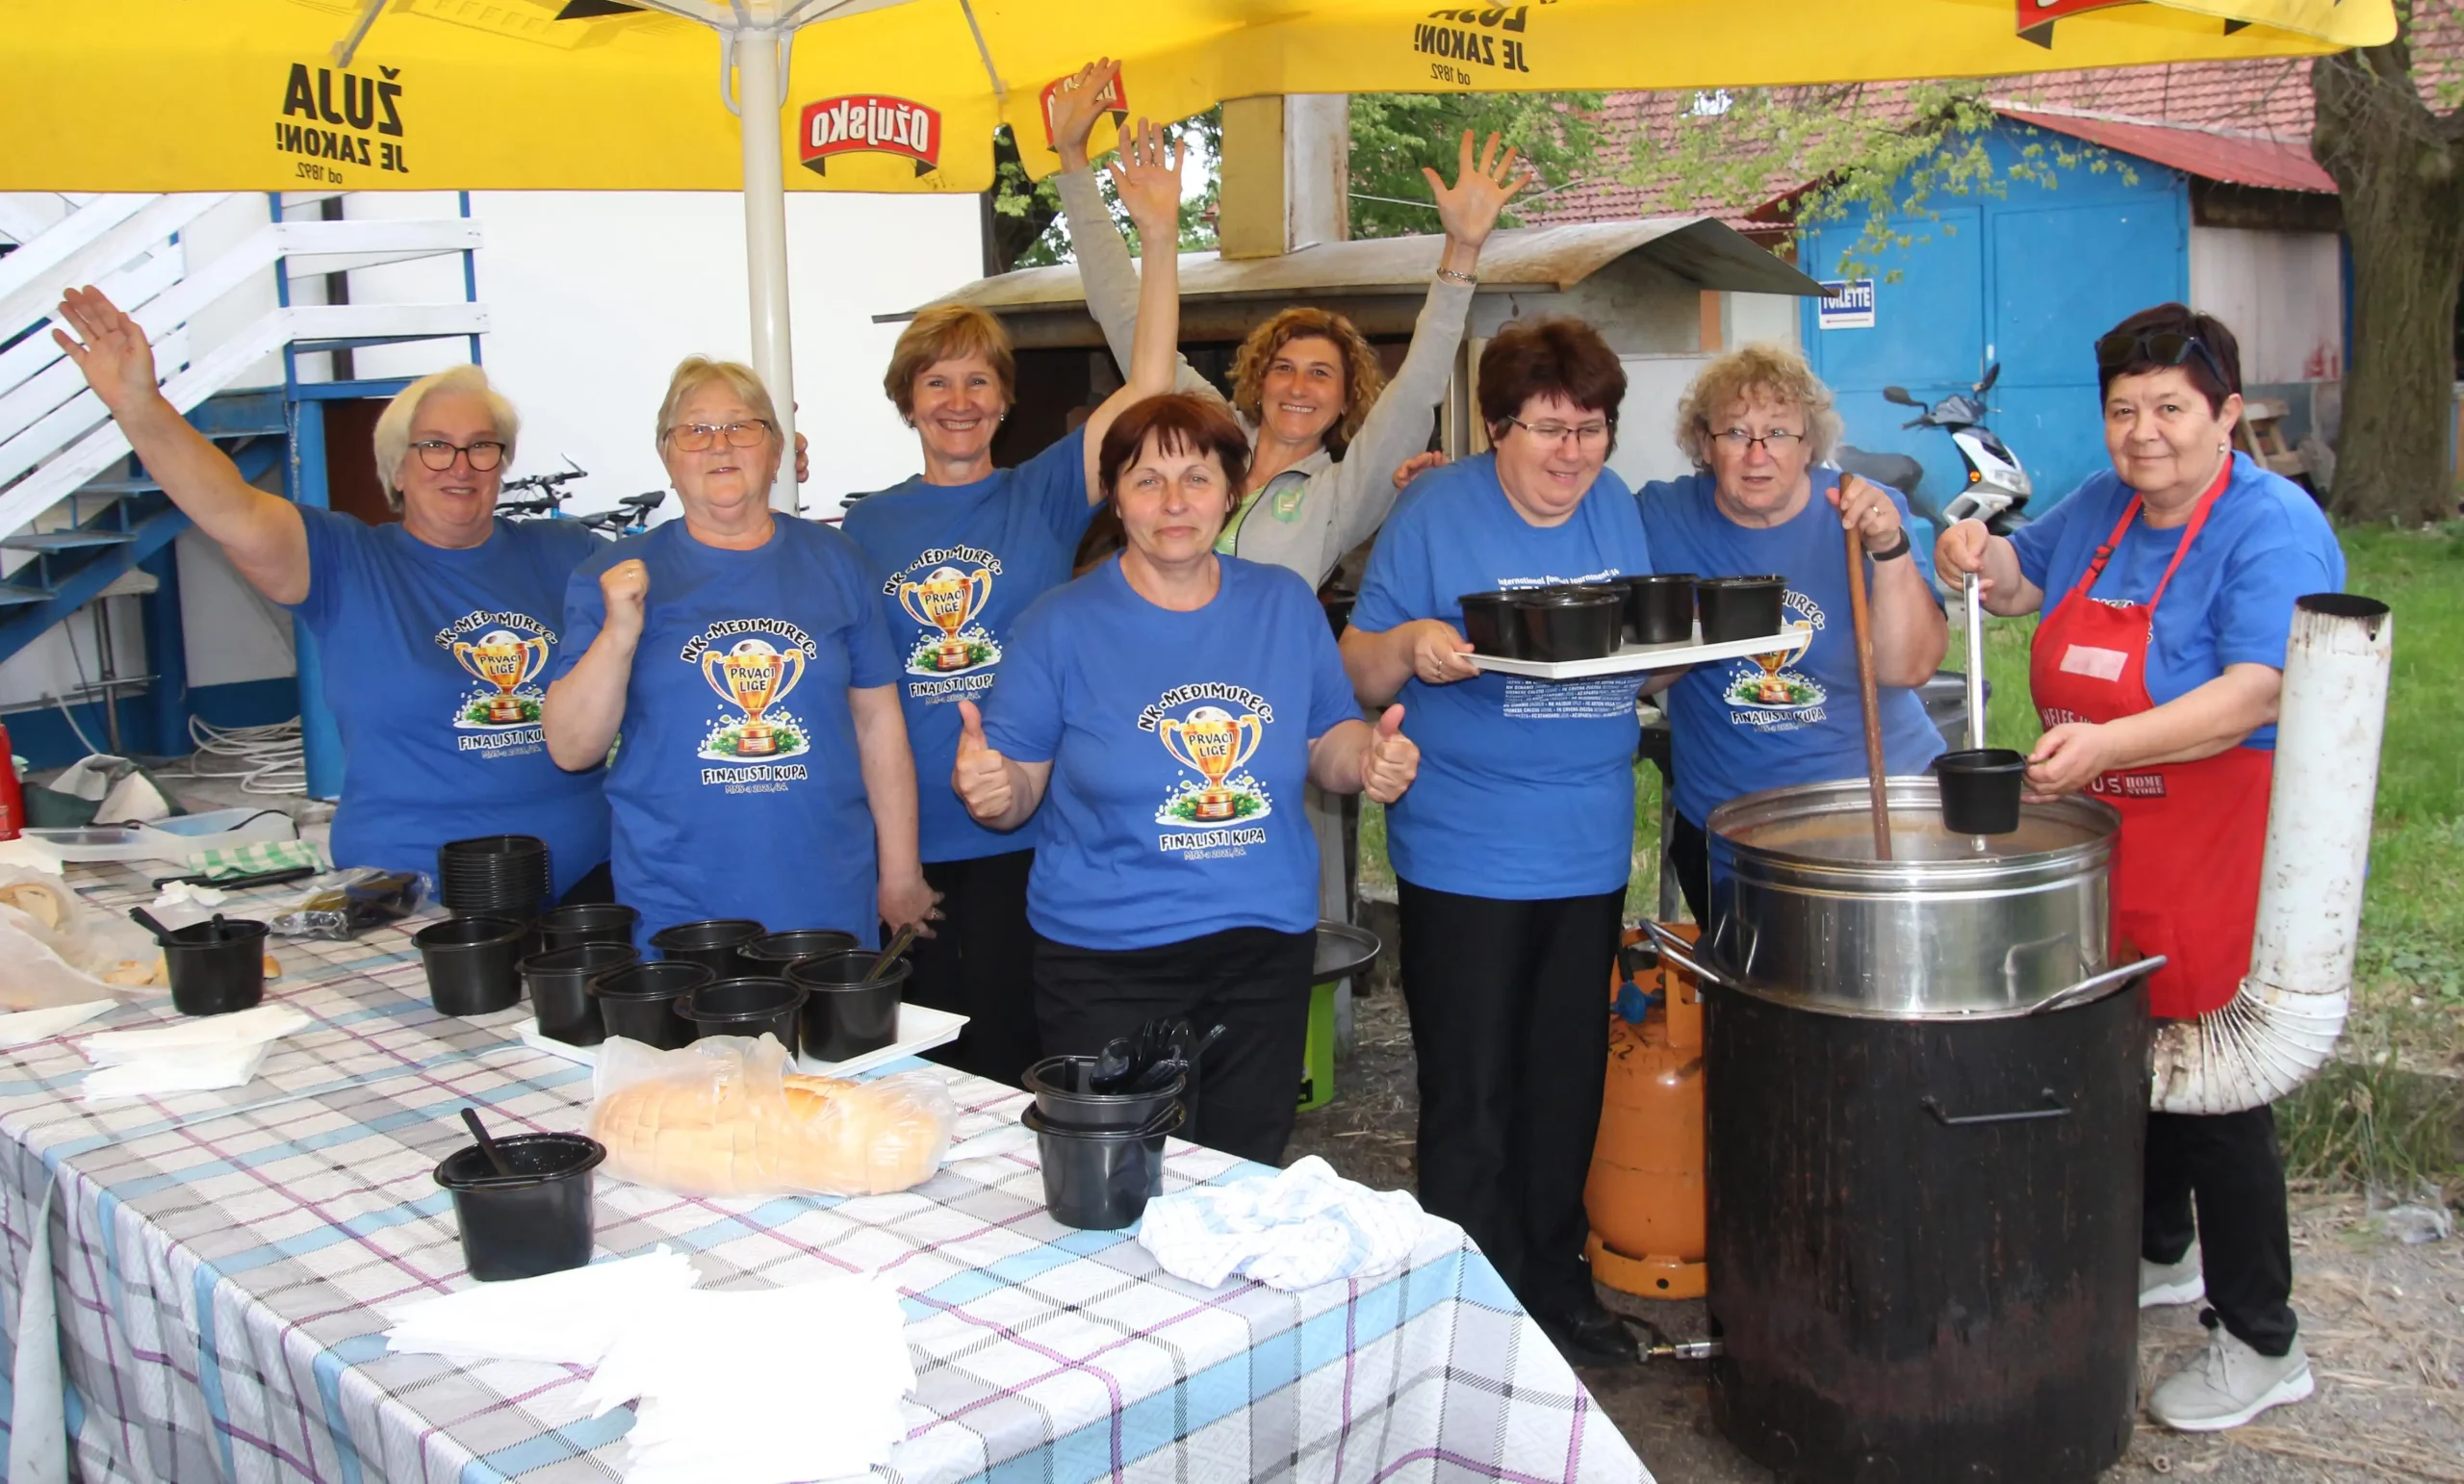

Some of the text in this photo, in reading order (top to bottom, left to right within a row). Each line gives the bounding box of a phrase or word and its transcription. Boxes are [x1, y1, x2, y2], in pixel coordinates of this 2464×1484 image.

[883, 572, 907, 596] NK
[935, 602, 960, 617] LIGE
[435, 627, 458, 650] NK
[680, 635, 707, 663] NK
[490, 664, 515, 675] LIGE
[731, 667, 775, 679] PRVACI
[740, 679, 766, 692] LIGE
[910, 678, 963, 698] FINALISTI
[1138, 704, 1164, 731] NK
[1732, 707, 1827, 725] FINALISTI KUPA
[458, 731, 523, 751] FINALISTI
[1189, 732, 1234, 745] PRVACI
[1199, 745, 1227, 757] LIGE
[702, 764, 808, 784] FINALISTI KUPA
[2125, 775, 2163, 787] HOME
[1159, 828, 1266, 852] FINALISTI KUPA
